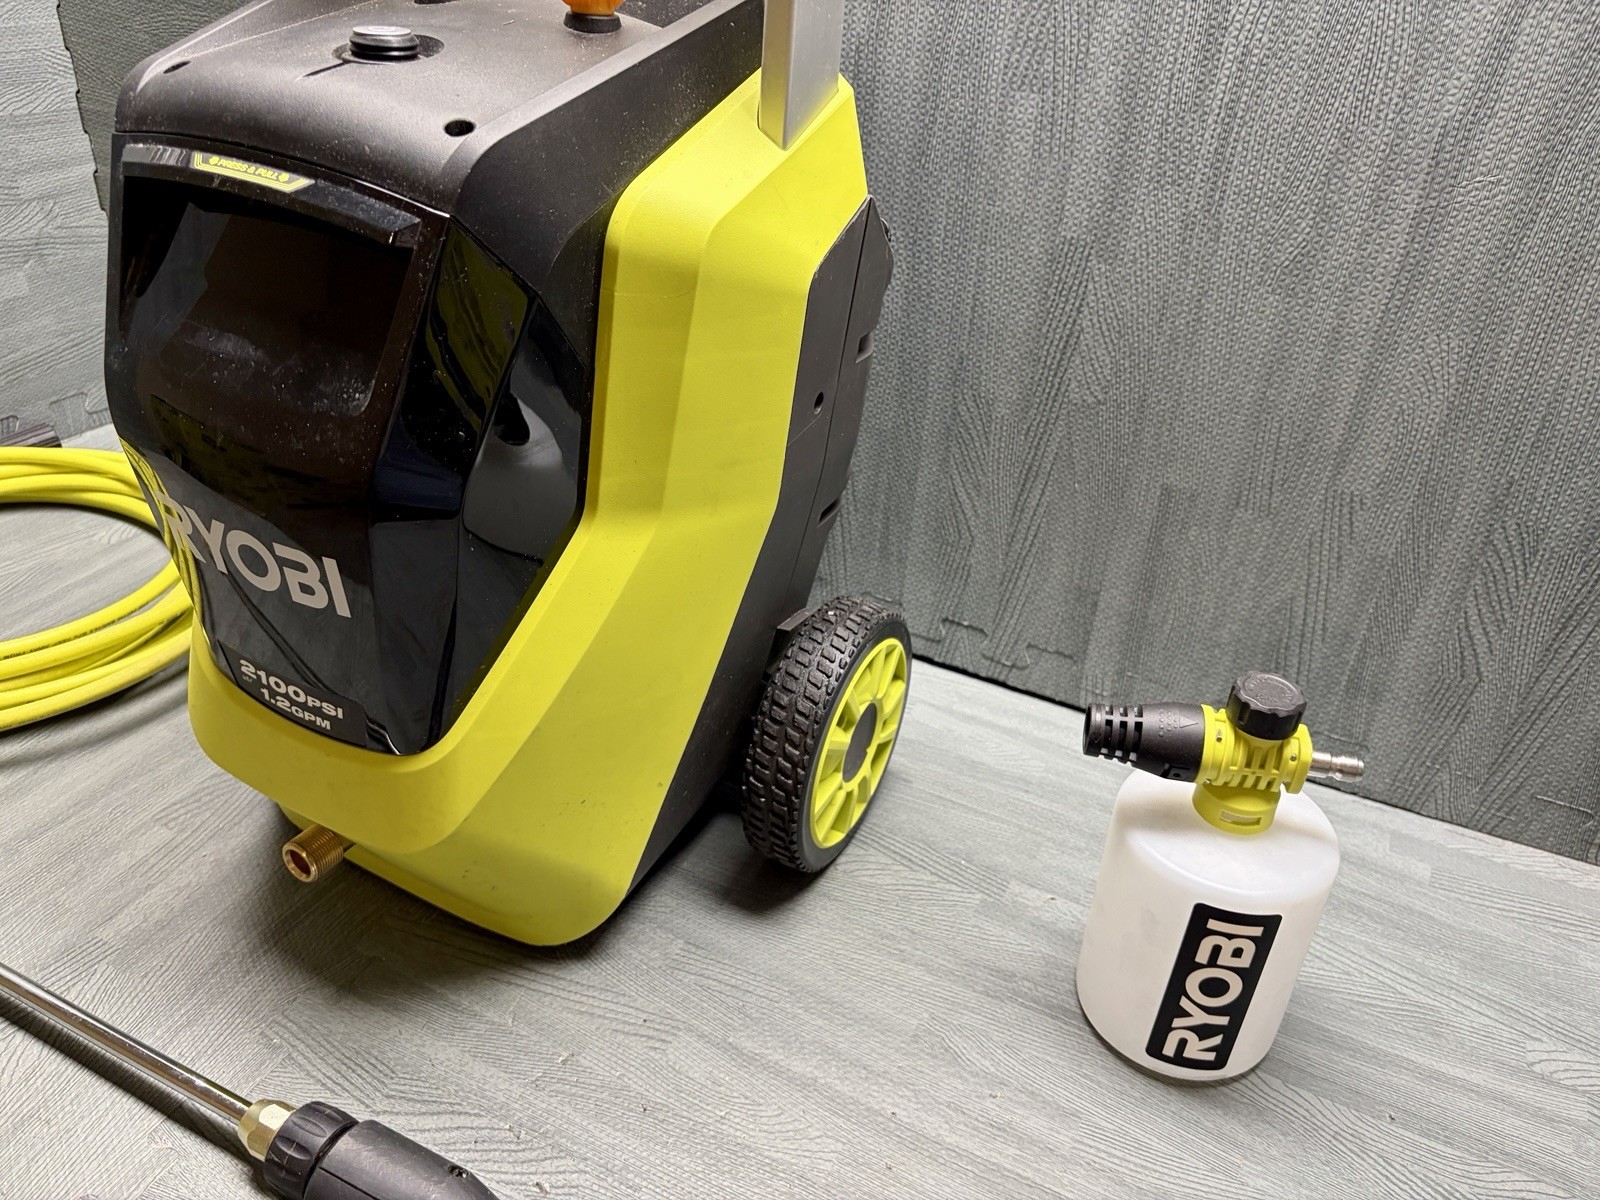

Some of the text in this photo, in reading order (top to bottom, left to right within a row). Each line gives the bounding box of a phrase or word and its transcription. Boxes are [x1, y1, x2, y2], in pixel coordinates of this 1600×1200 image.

[217, 158, 278, 180] PRESS & PULL
[154, 489, 352, 618] RYOBI
[1161, 918, 1264, 1061] RYOBI
